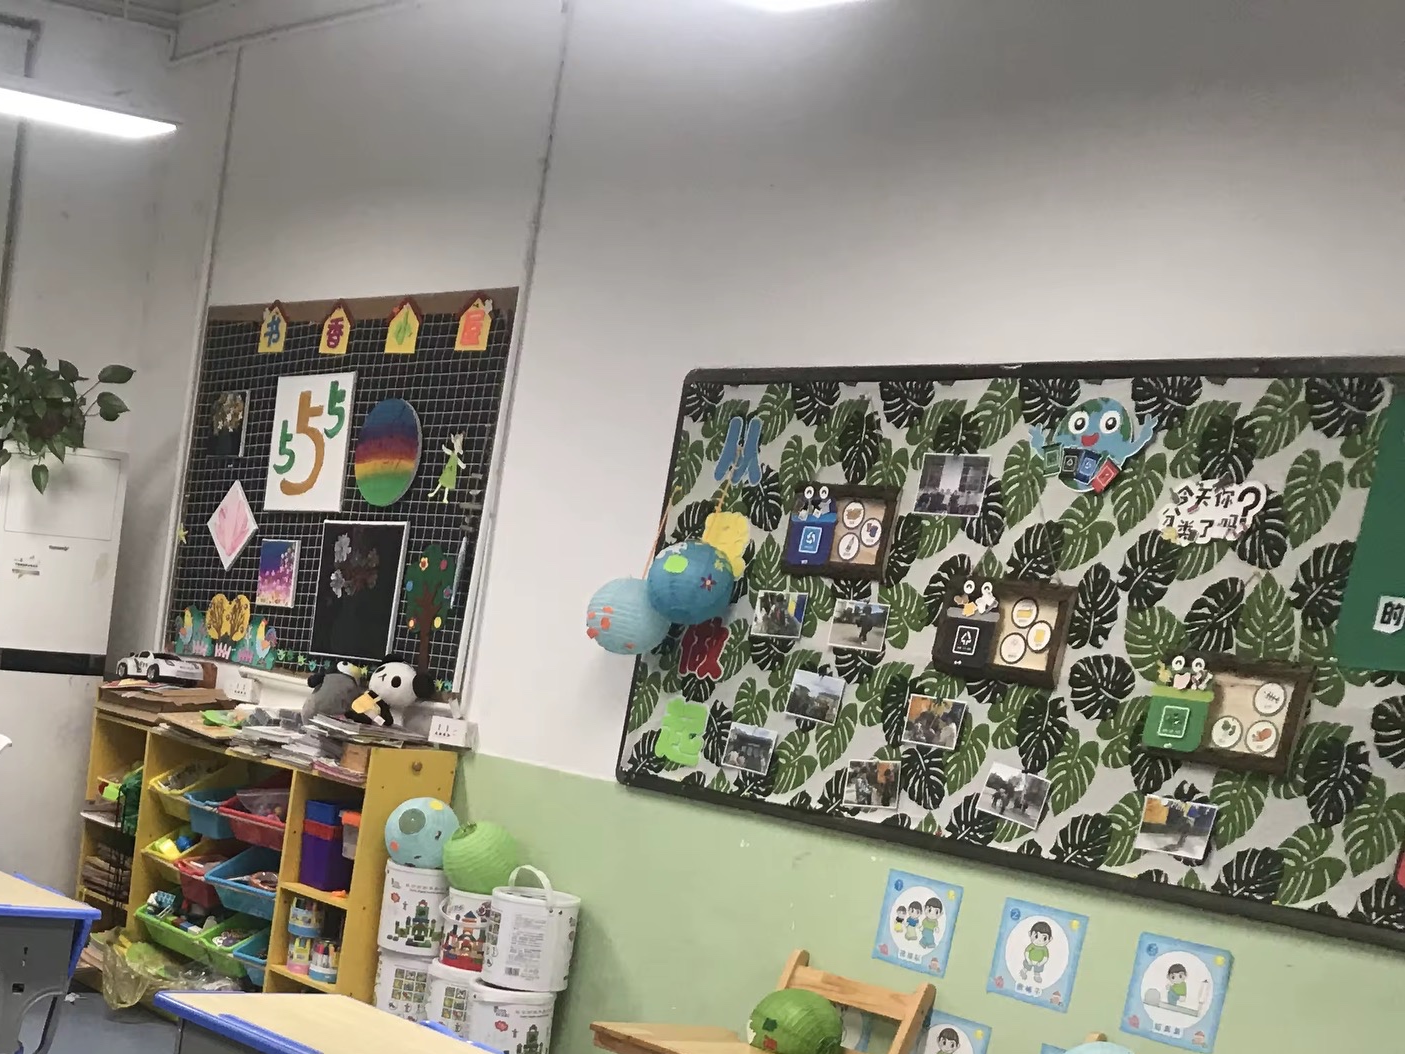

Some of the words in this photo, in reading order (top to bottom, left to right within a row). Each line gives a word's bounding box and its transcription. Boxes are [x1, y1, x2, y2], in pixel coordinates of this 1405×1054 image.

[1177, 484, 1236, 509] 今天你
[1380, 601, 1405, 627] 的
